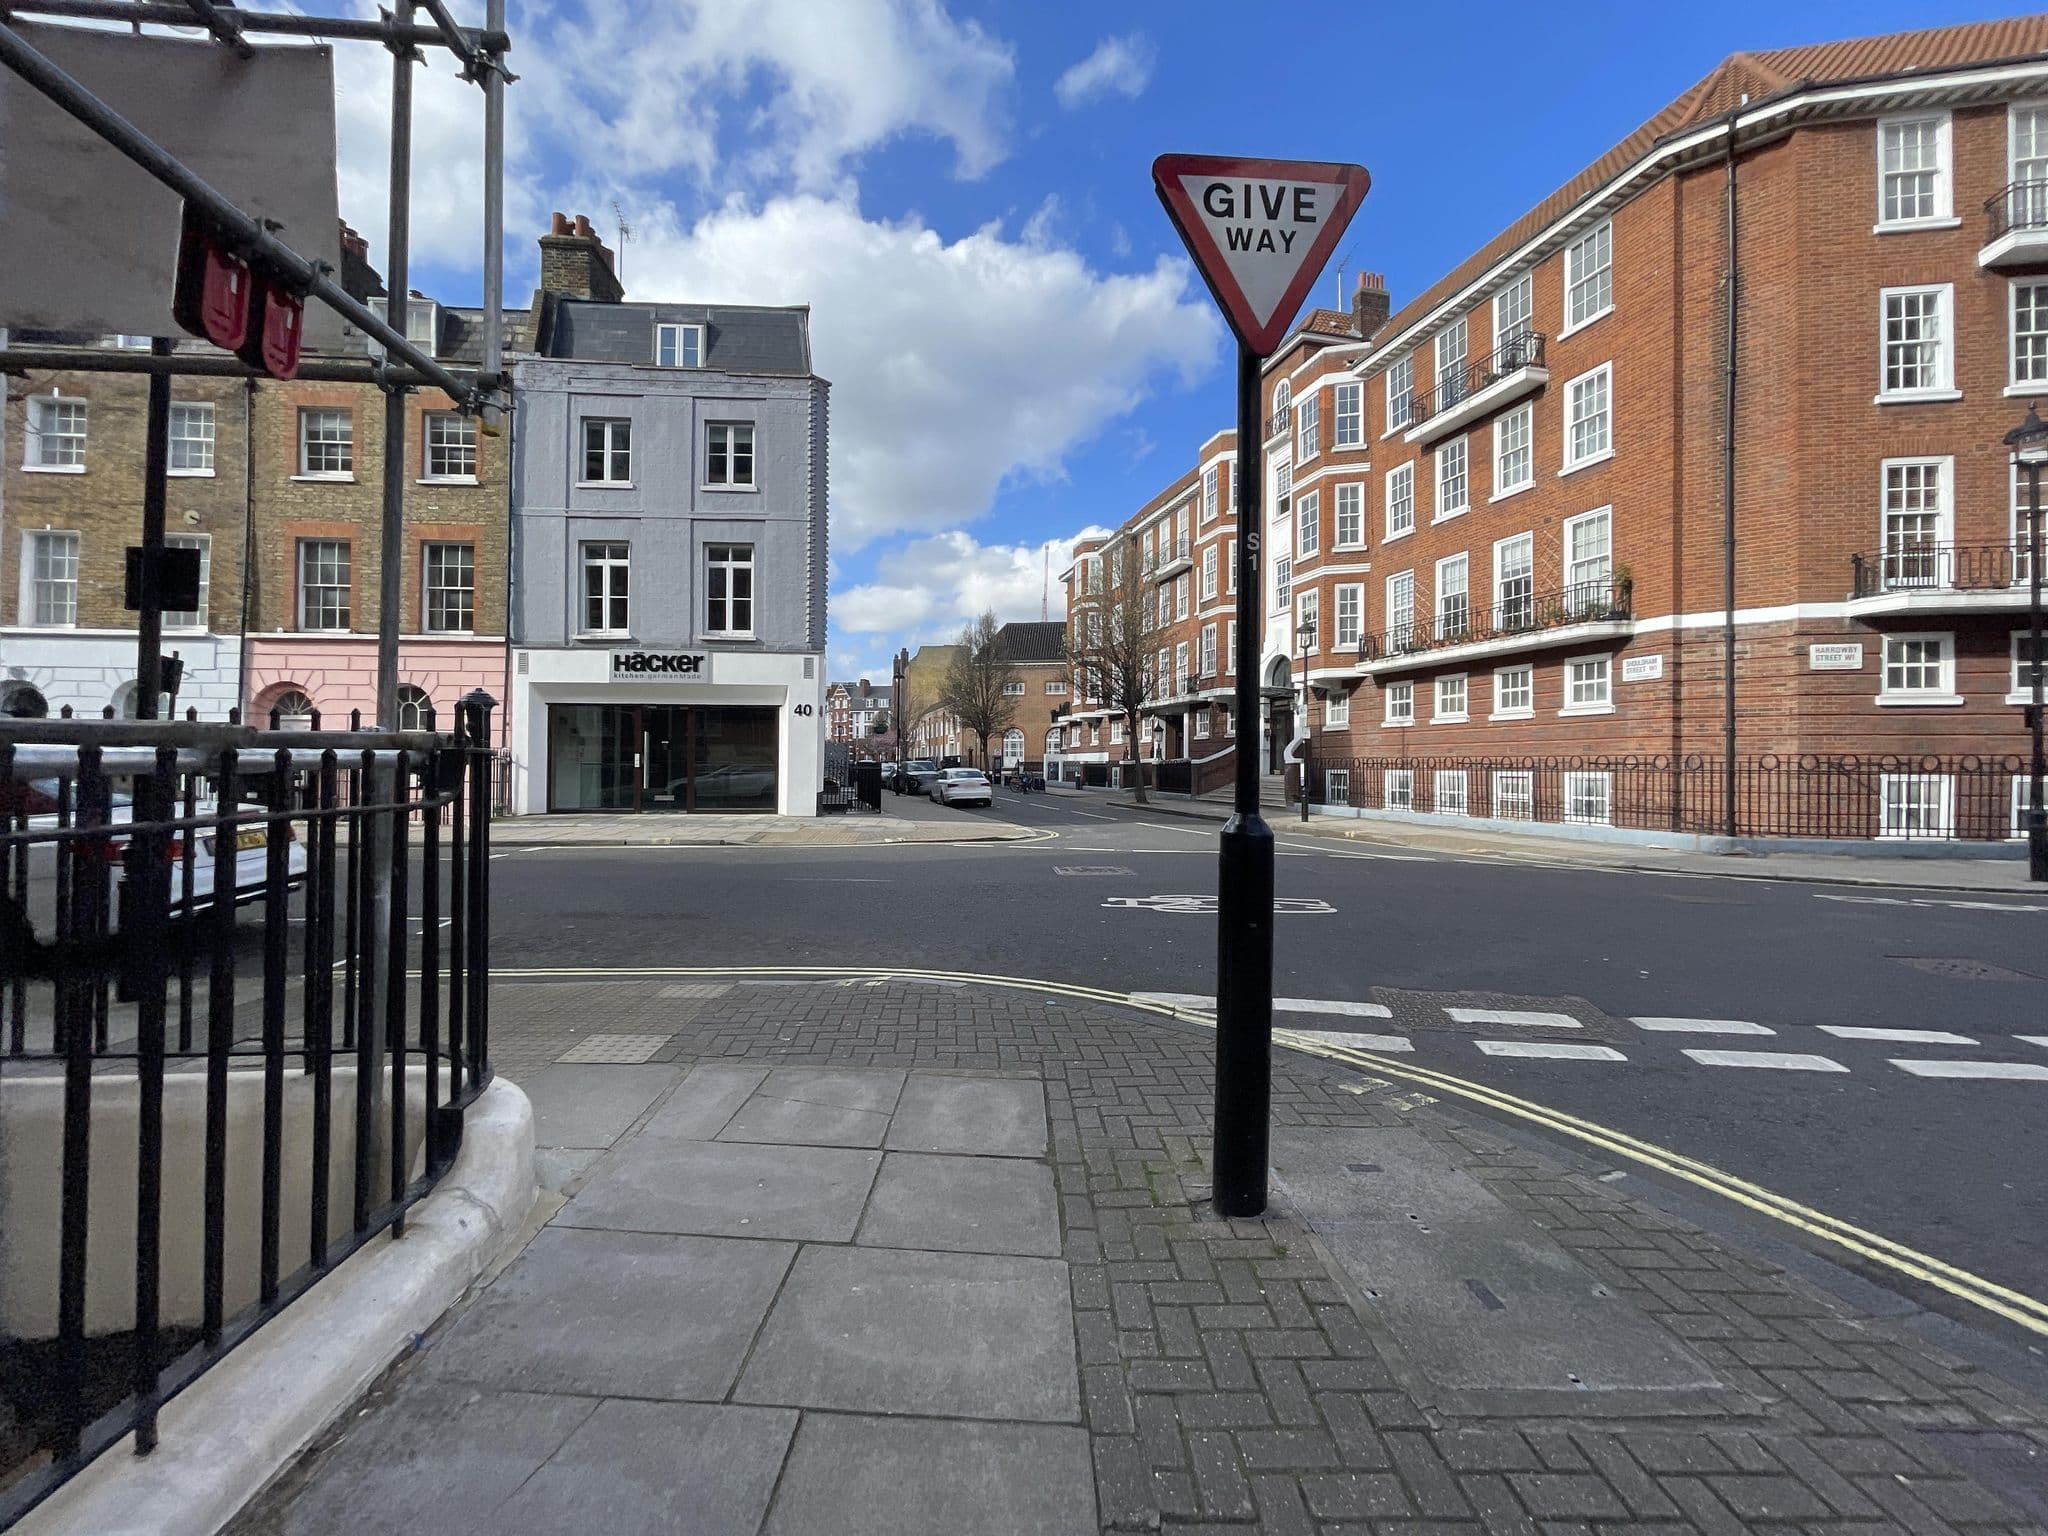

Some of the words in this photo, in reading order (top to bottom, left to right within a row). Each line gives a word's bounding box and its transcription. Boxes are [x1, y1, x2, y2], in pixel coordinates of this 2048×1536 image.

[1203, 183, 1317, 223] GIVE
[1226, 226, 1297, 254] WAY
[1815, 654, 1842, 662] STREET
[1625, 666, 1647, 674] STREET
[794, 704, 812, 717] 40
